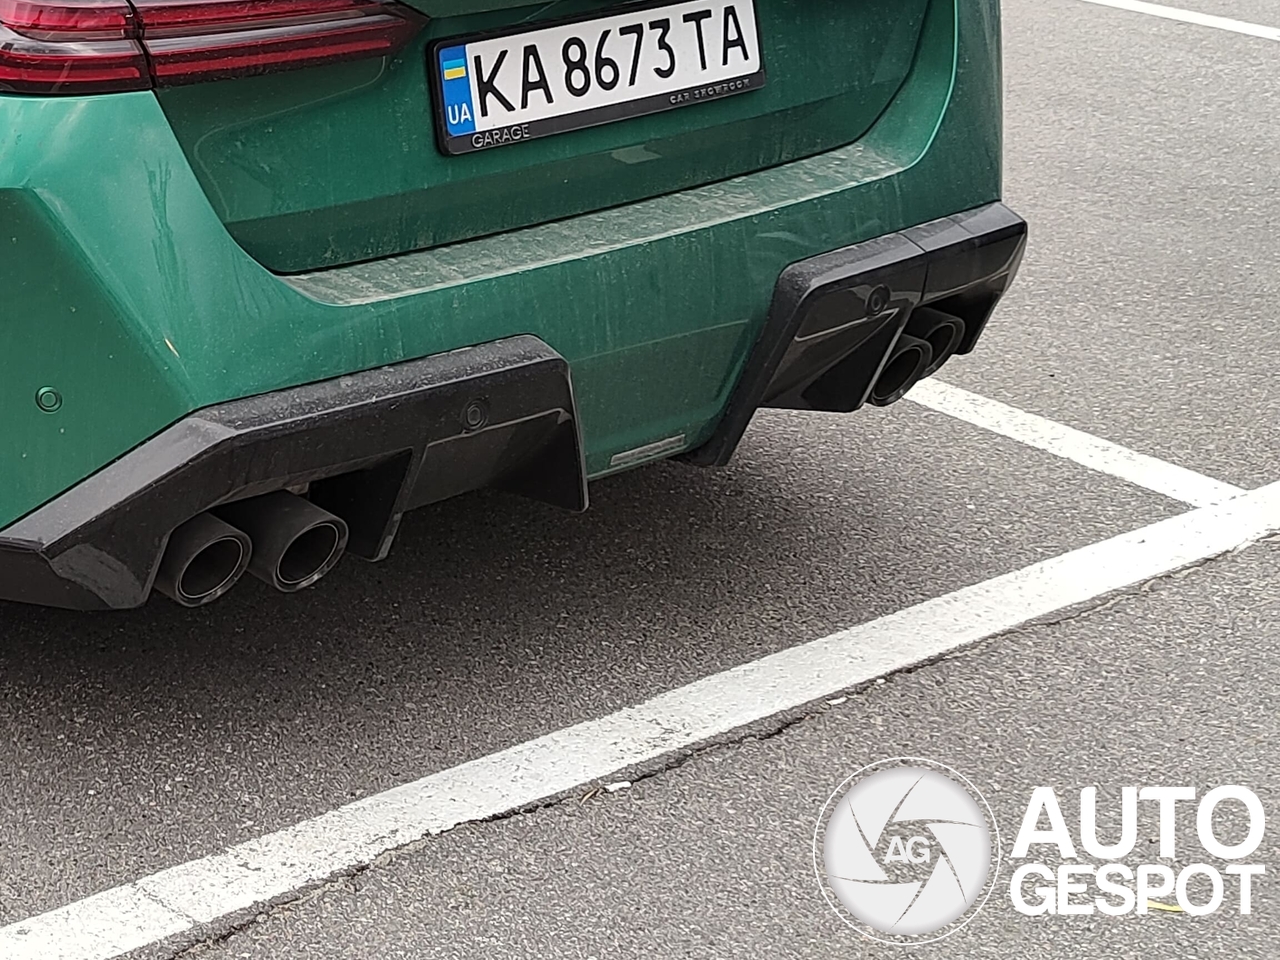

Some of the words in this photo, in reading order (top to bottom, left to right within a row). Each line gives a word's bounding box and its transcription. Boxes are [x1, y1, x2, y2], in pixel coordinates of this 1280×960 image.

[474, 44, 554, 117] KA
[562, 18, 676, 97] 8673
[683, 5, 750, 71] TA
[669, 92, 690, 104] CAR
[448, 103, 472, 124] UA
[472, 124, 531, 147] GARAGE
